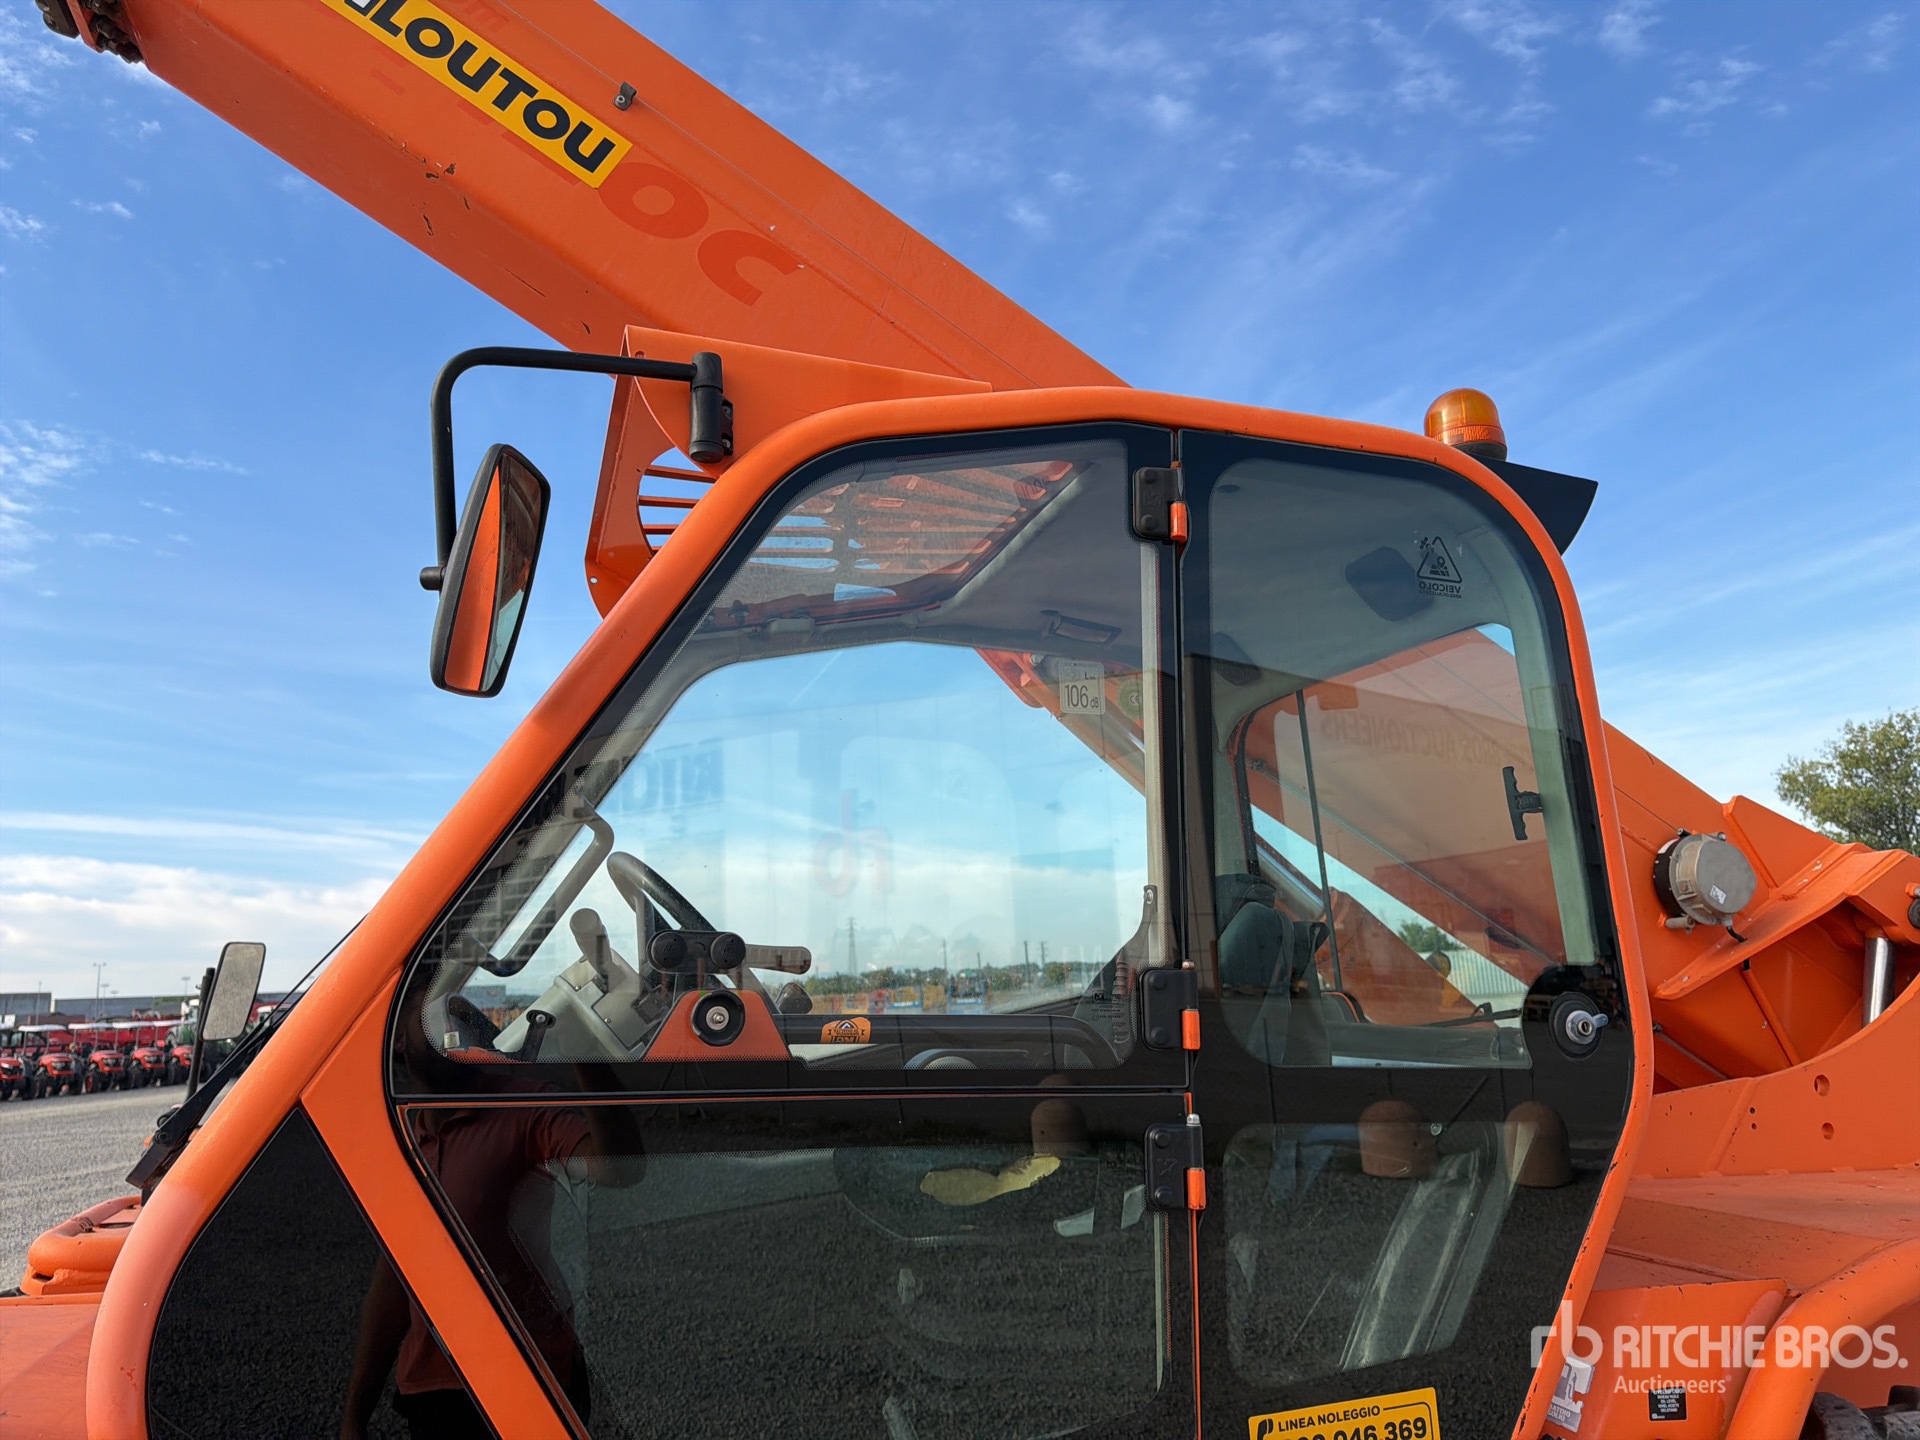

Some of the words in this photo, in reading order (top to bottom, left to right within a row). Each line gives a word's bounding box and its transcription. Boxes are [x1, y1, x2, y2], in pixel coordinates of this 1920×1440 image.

[1064, 684, 1089, 708] 106
[1090, 696, 1099, 708] dB
[1278, 1416, 1316, 1432] LINEA
[1317, 1405, 1381, 1425] NOLEGGIO
